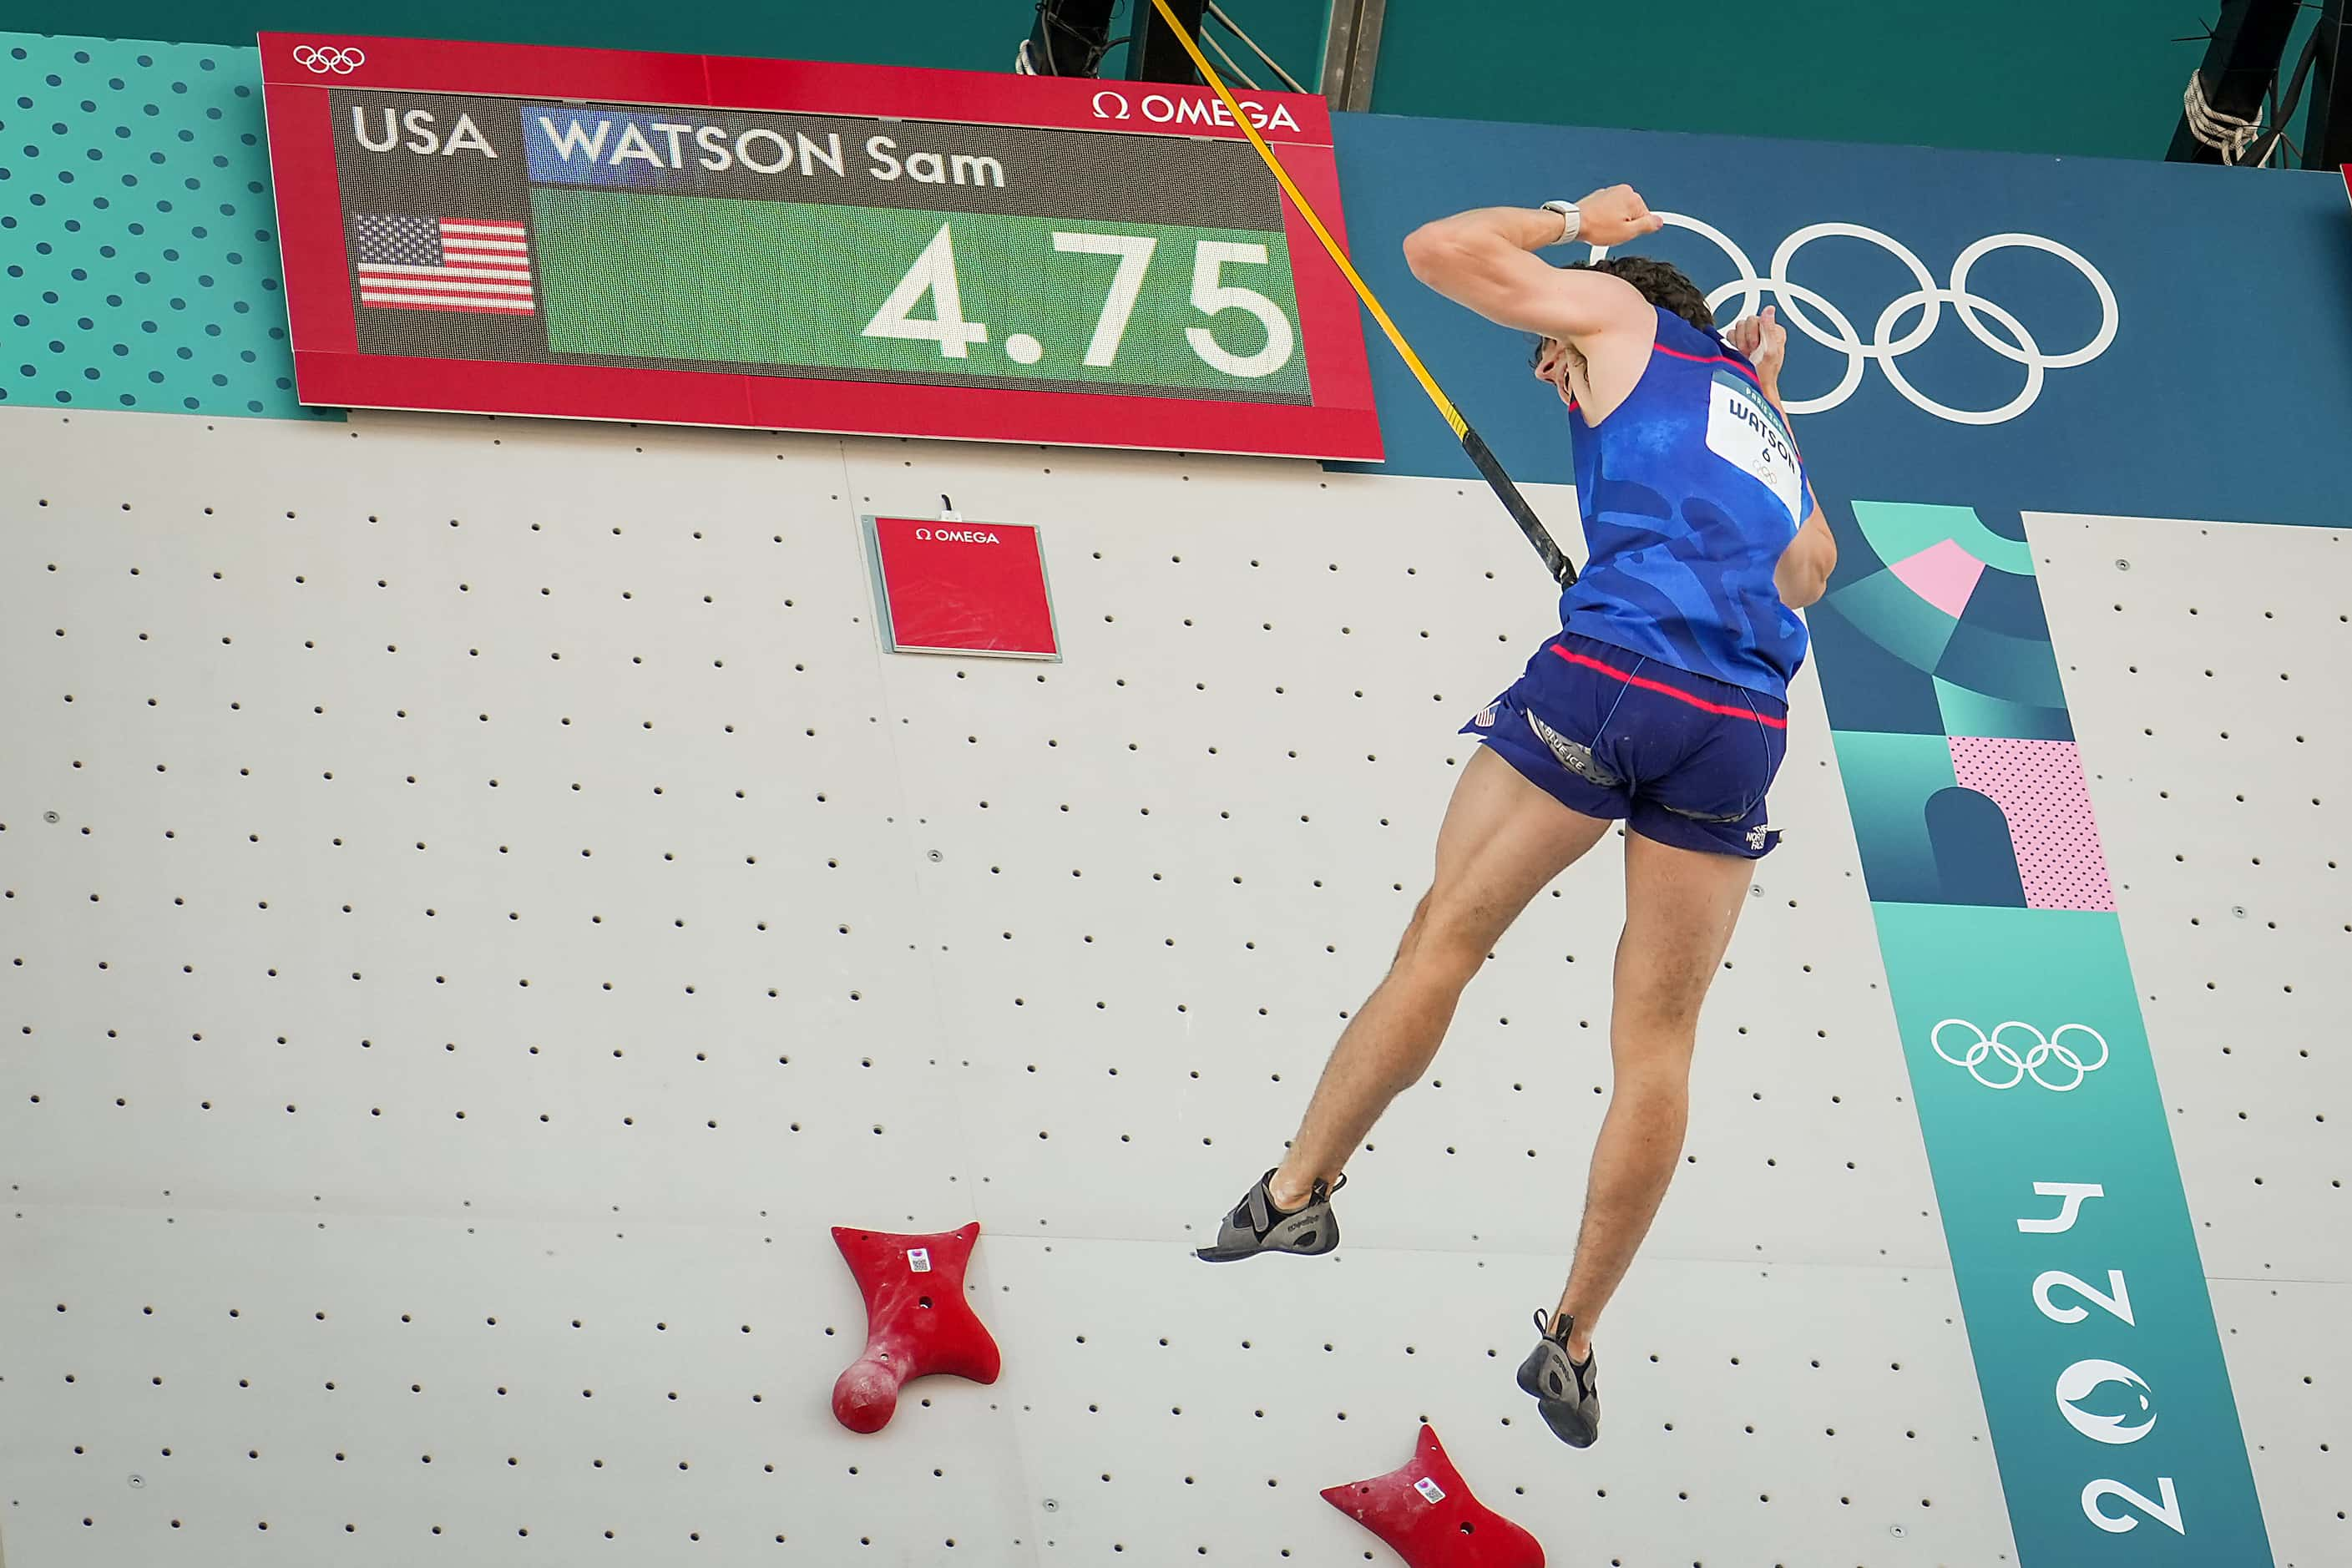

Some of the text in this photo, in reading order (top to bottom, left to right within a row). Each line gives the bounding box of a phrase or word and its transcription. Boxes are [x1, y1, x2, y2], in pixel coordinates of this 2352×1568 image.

[1141, 94, 1301, 132] OMEGA
[352, 106, 1004, 187] USA WATSON Sam
[862, 221, 1294, 378] 4.75
[1730, 399, 1795, 474] WATSON
[1762, 448, 1771, 463] 6
[935, 529, 999, 544] OMEGA
[1545, 726, 1585, 770] BLUE ICE
